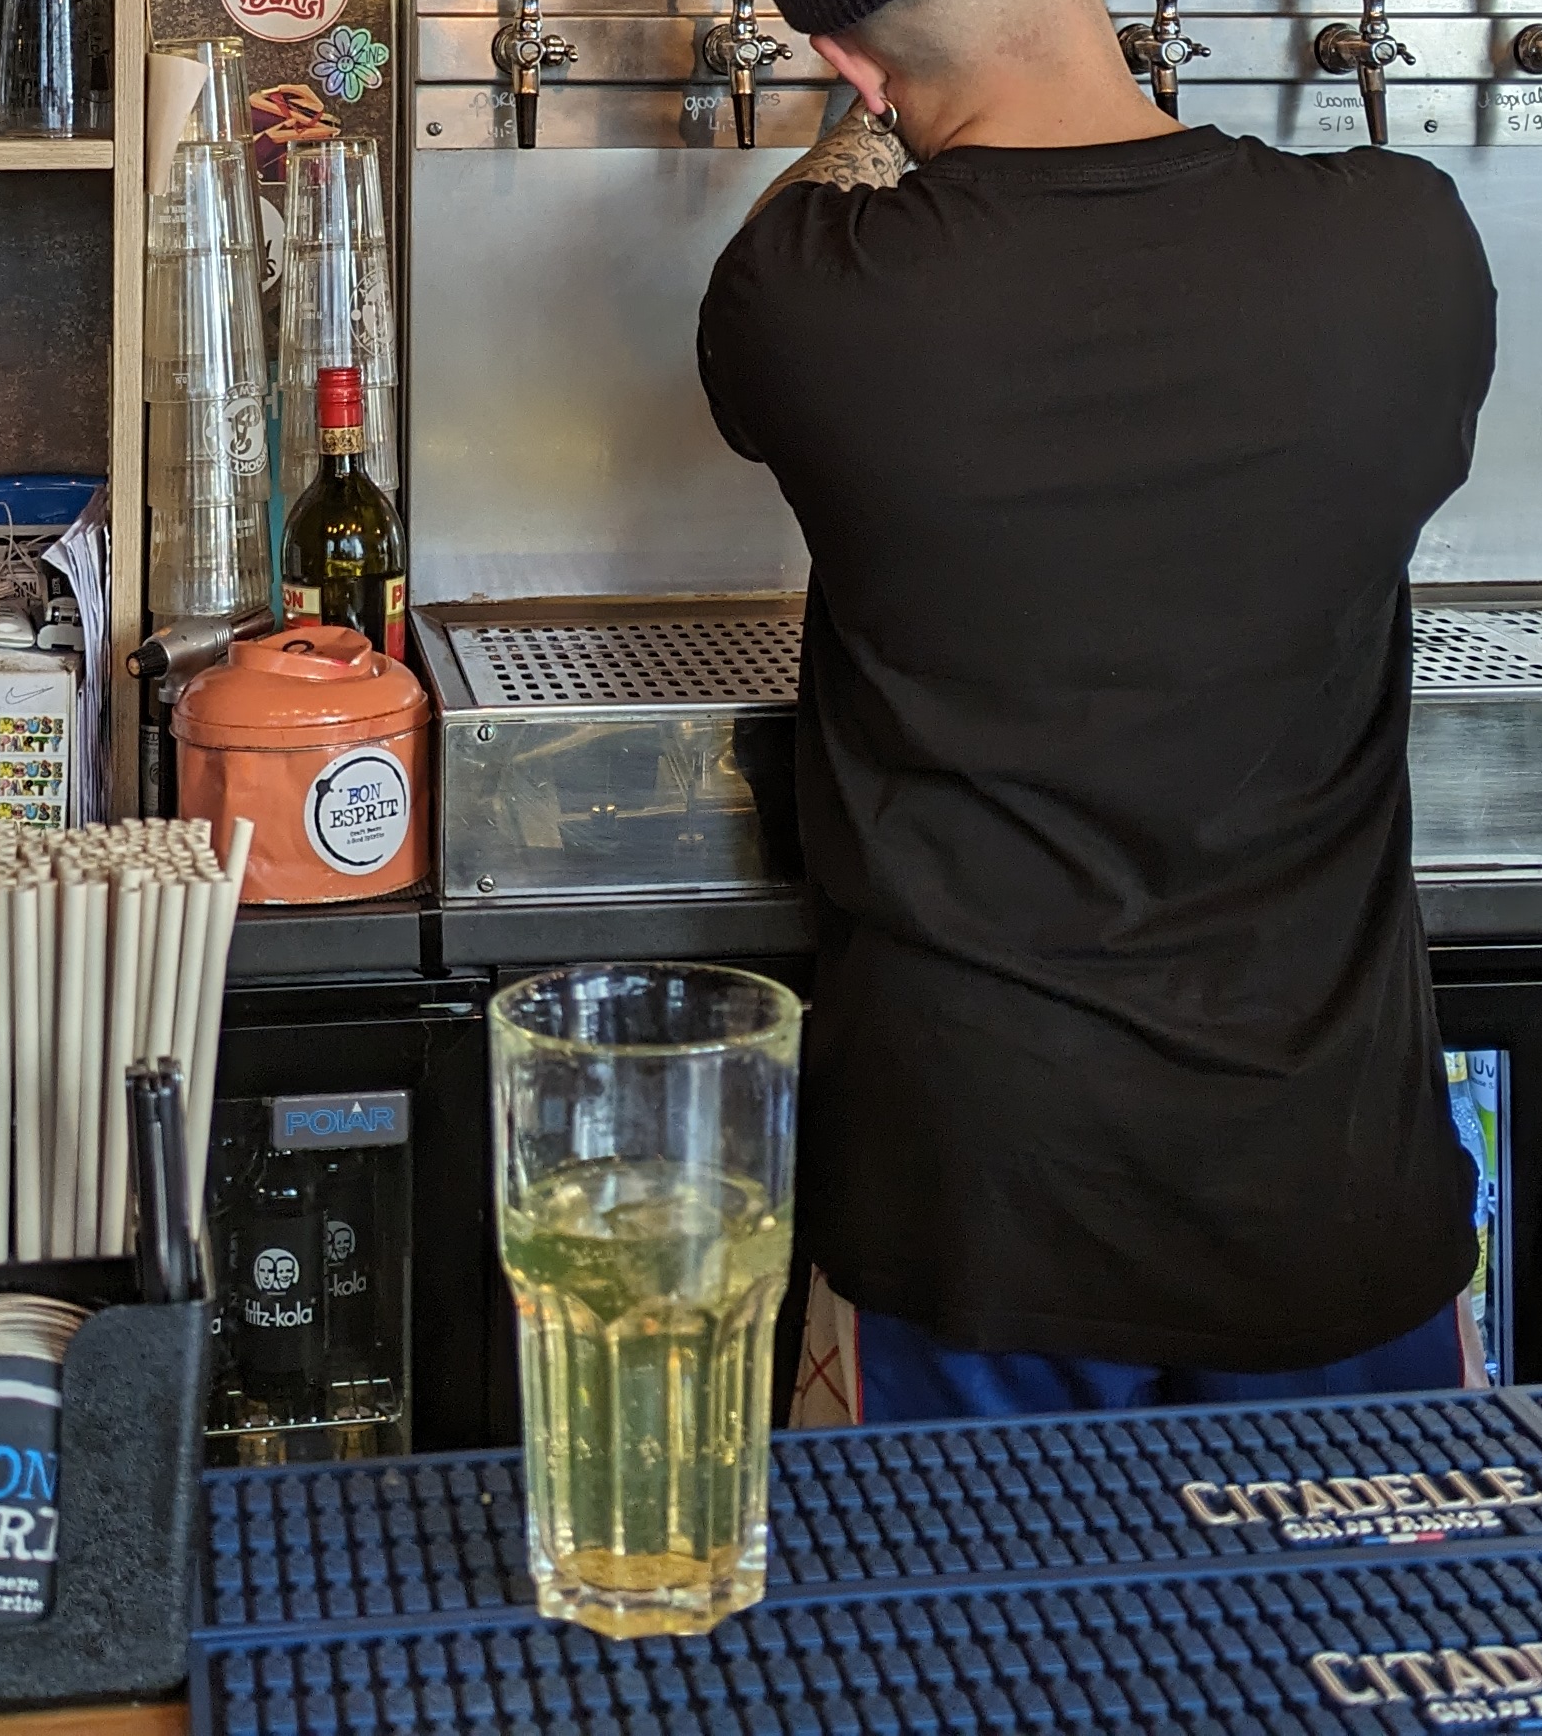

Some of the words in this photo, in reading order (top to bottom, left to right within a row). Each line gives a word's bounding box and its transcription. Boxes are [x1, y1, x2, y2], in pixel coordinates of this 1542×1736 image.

[1319, 115, 1356, 132] 5/9
[347, 783, 382, 805] BON
[330, 799, 399, 828] ESPRIT
[285, 1106, 395, 1136] POLAR
[245, 1298, 313, 1327] fritz-kola
[1281, 1518, 1343, 1541] GIN
[1380, 1510, 1502, 1534] FRANCE
[1426, 1700, 1492, 1724] GIN
